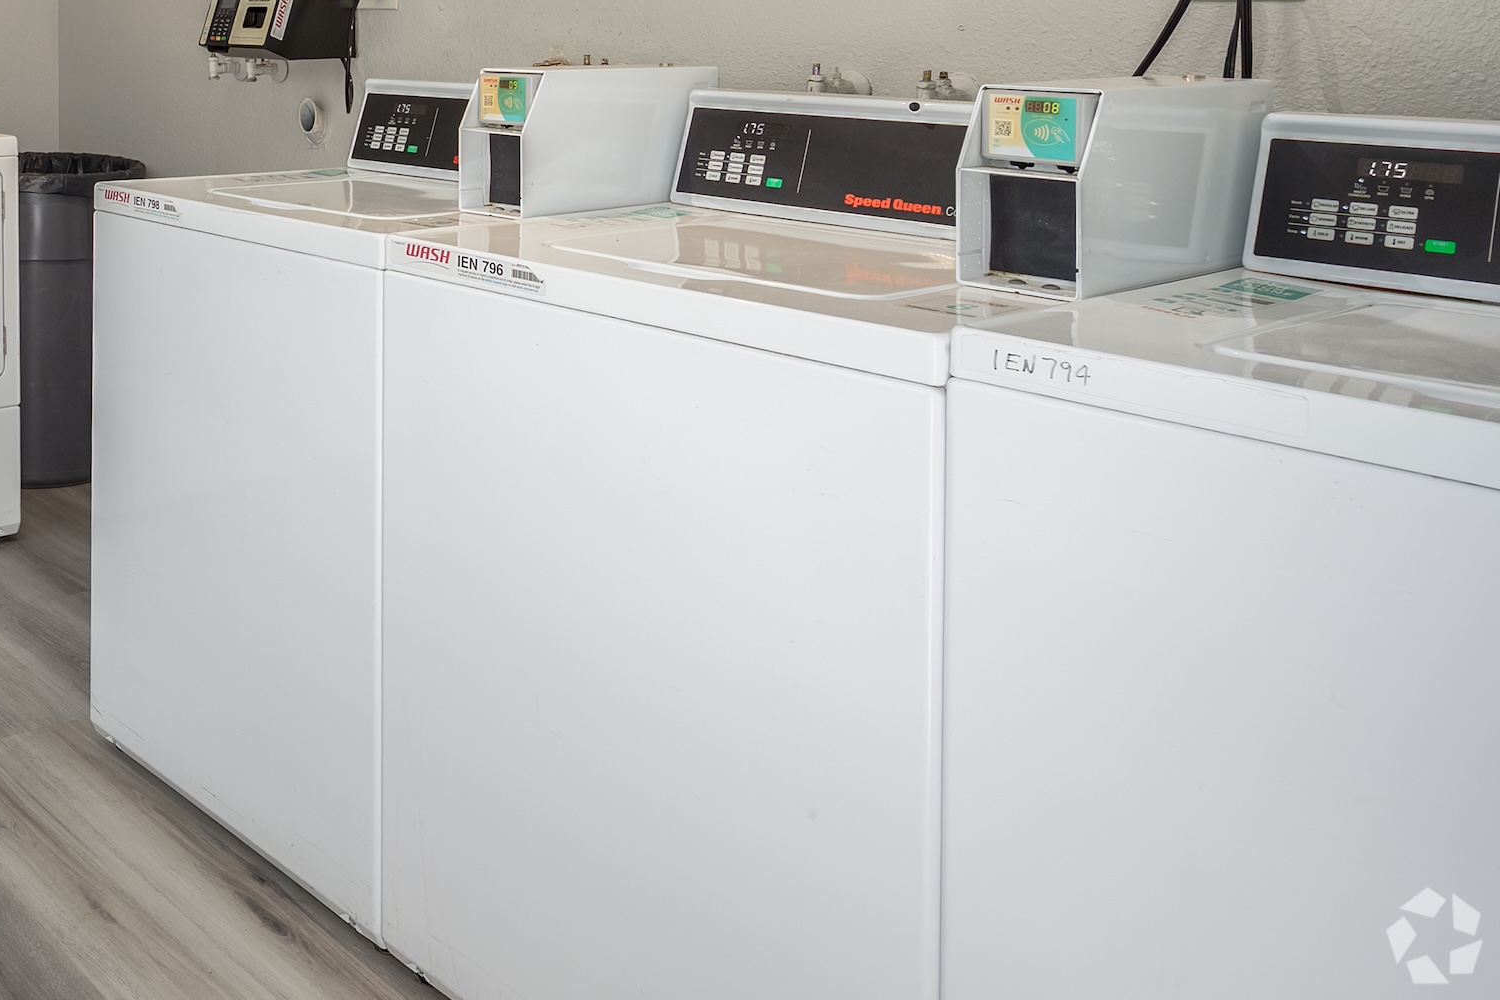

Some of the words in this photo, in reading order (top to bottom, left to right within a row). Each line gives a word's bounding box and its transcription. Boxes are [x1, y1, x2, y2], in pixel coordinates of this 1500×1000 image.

[1043, 102, 1059, 114] 08
[1369, 161, 1408, 178] 1.75
[104, 190, 130, 203] WASH
[134, 196, 146, 207] IEN
[148, 199, 160, 210] 798
[844, 193, 891, 208] Speed
[892, 199, 942, 215] Queen
[406, 243, 450, 264] WASH
[457, 255, 478, 270] IEN
[482, 261, 504, 276] 796
[994, 350, 1036, 373] IEN
[1042, 357, 1090, 386] 794
